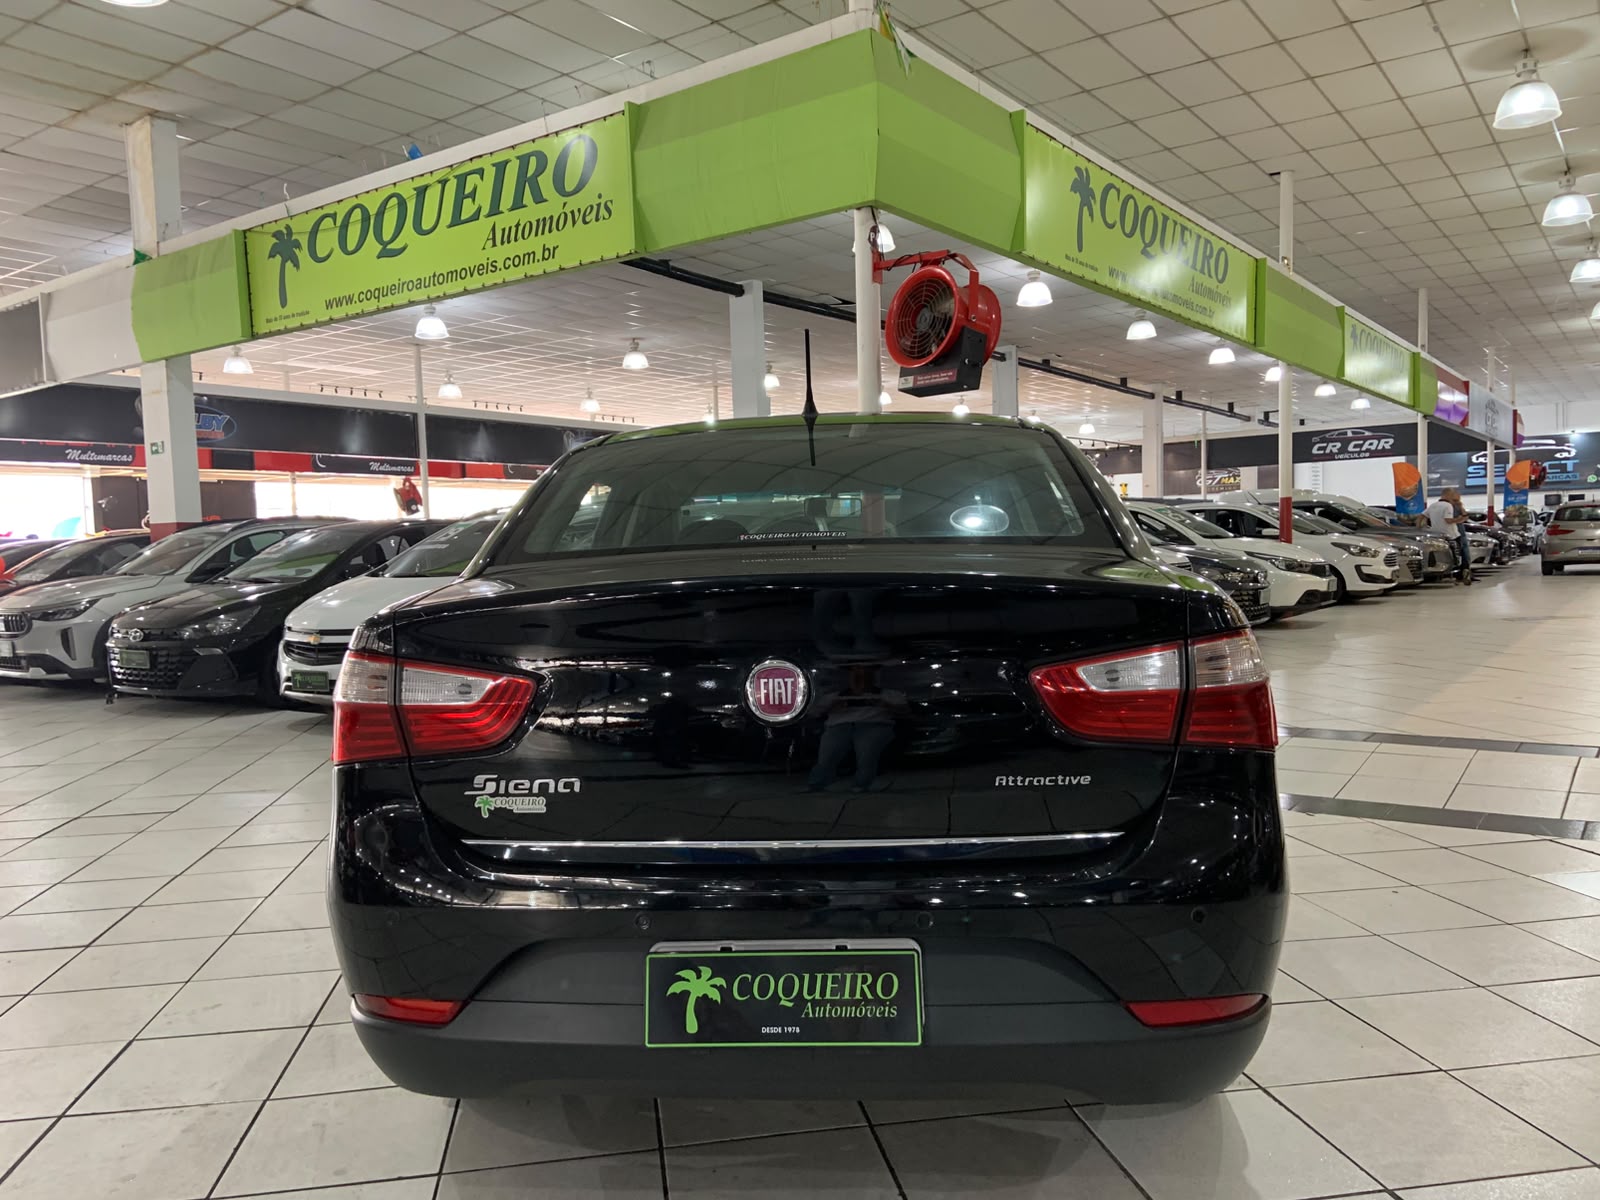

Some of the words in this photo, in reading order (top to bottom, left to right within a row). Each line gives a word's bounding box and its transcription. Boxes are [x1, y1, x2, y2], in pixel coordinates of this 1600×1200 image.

[306, 134, 598, 263] COQUEIRO
[482, 193, 613, 250] Automóveis
[1100, 182, 1229, 284] COQUEIRO
[324, 244, 559, 311] www.coqueiroautomoveis.com.br
[1188, 275, 1232, 308] Automóveis
[65, 449, 133, 461] Multimarcas
[1312, 442, 1342, 454] CR
[1347, 438, 1395, 452] CAR
[760, 678, 795, 705] FIAT
[464, 774, 581, 795] Siena
[995, 774, 1092, 786] Attractive
[494, 798, 546, 809] COQUEIRO
[732, 972, 899, 1008] COQUEIRO
[801, 1001, 898, 1018] Automóveis
[761, 1026, 782, 1034] DESDE
[784, 1026, 800, 1034] 1978
